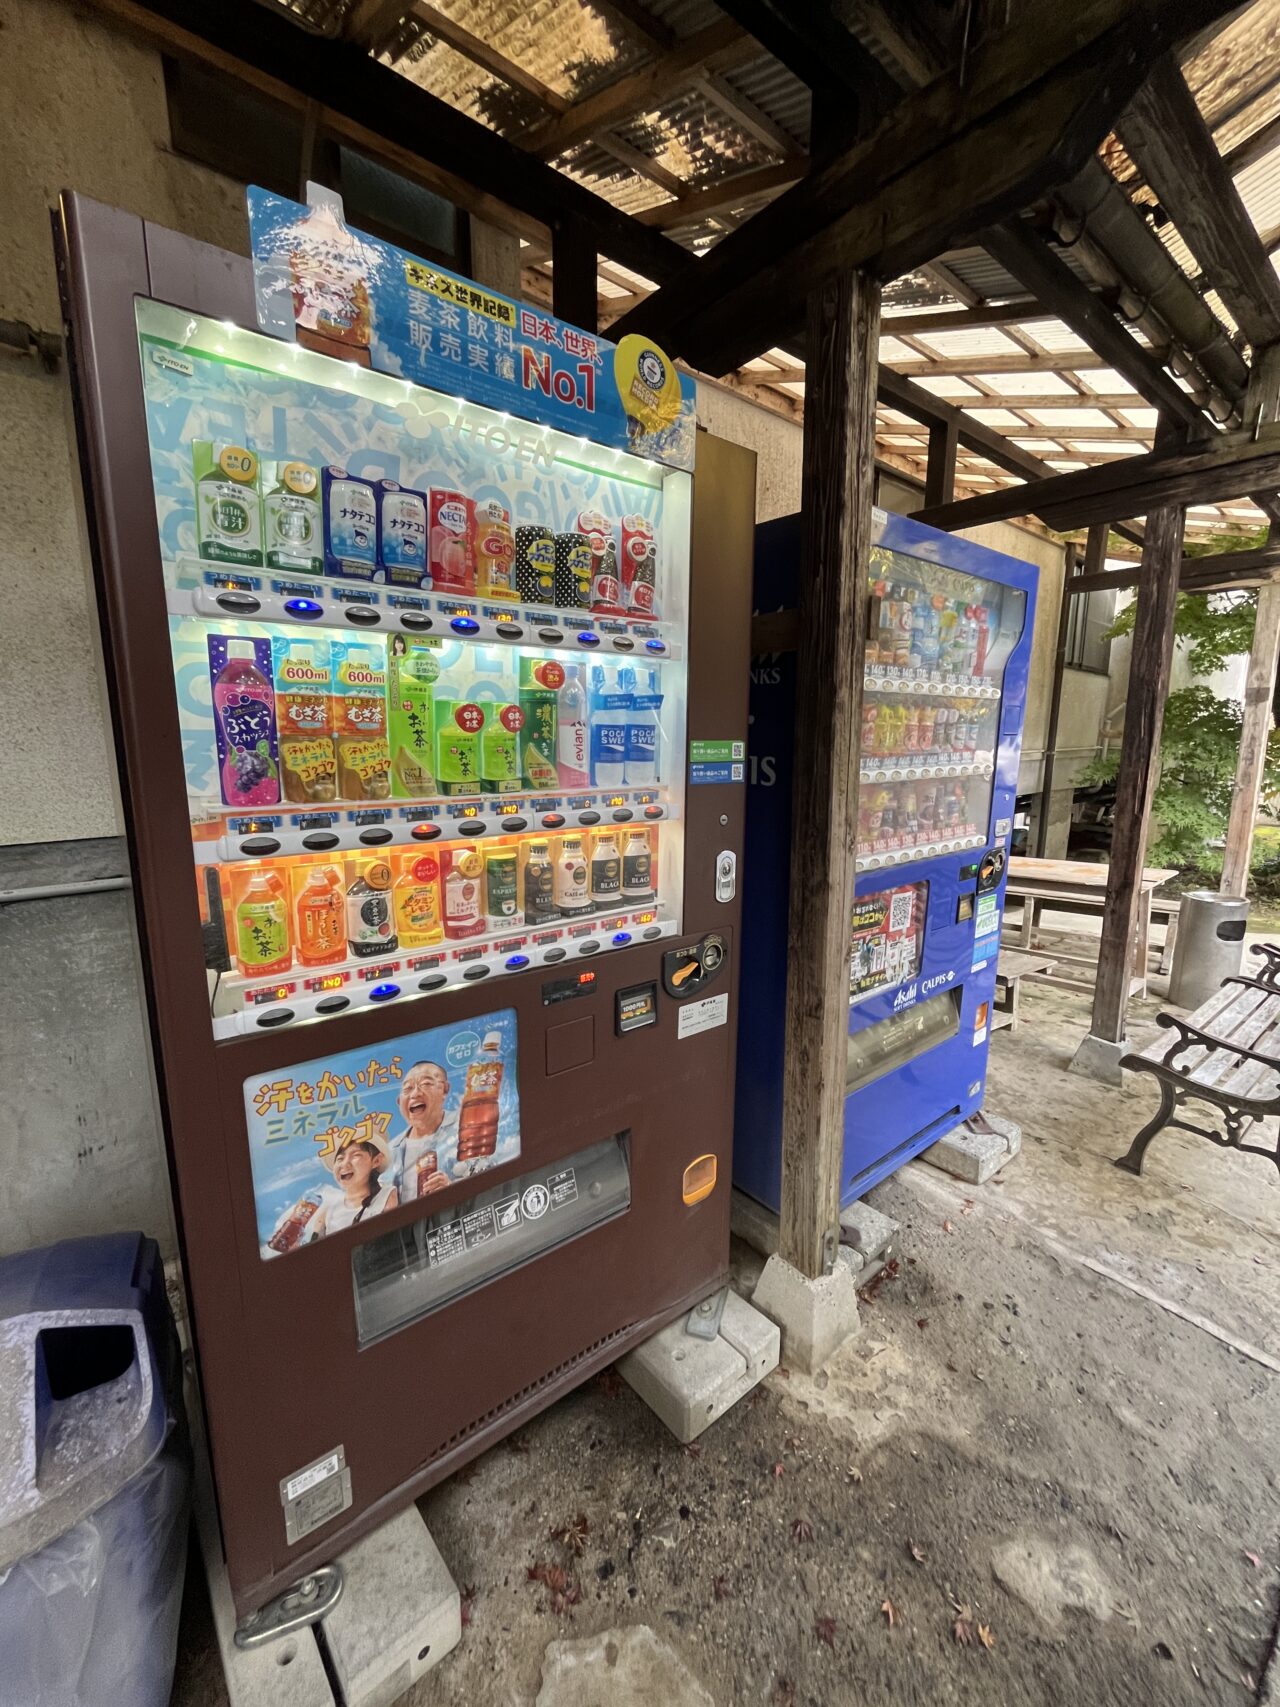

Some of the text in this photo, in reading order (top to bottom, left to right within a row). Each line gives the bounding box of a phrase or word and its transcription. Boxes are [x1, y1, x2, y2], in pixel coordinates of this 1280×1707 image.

[408, 289, 514, 352] 麦茶飲料
[522, 345, 595, 413] No.1
[453, 420, 559, 468] ITO EN
[286, 667, 328, 682] 600ml
[348, 671, 385, 685] 600ml
[227, 709, 272, 735] ぶどう
[288, 704, 329, 722] むぎ茶
[347, 706, 384, 723] むぎ茶
[574, 727, 585, 762] evian
[323, 977, 341, 988] 140
[894, 984, 917, 1007] Asahi
[921, 973, 946, 994] CALPIS
[252, 1056, 404, 1117] 汗をかいたら
[264, 1094, 367, 1146] ミネラル
[313, 1111, 393, 1158] ゴクゴク
